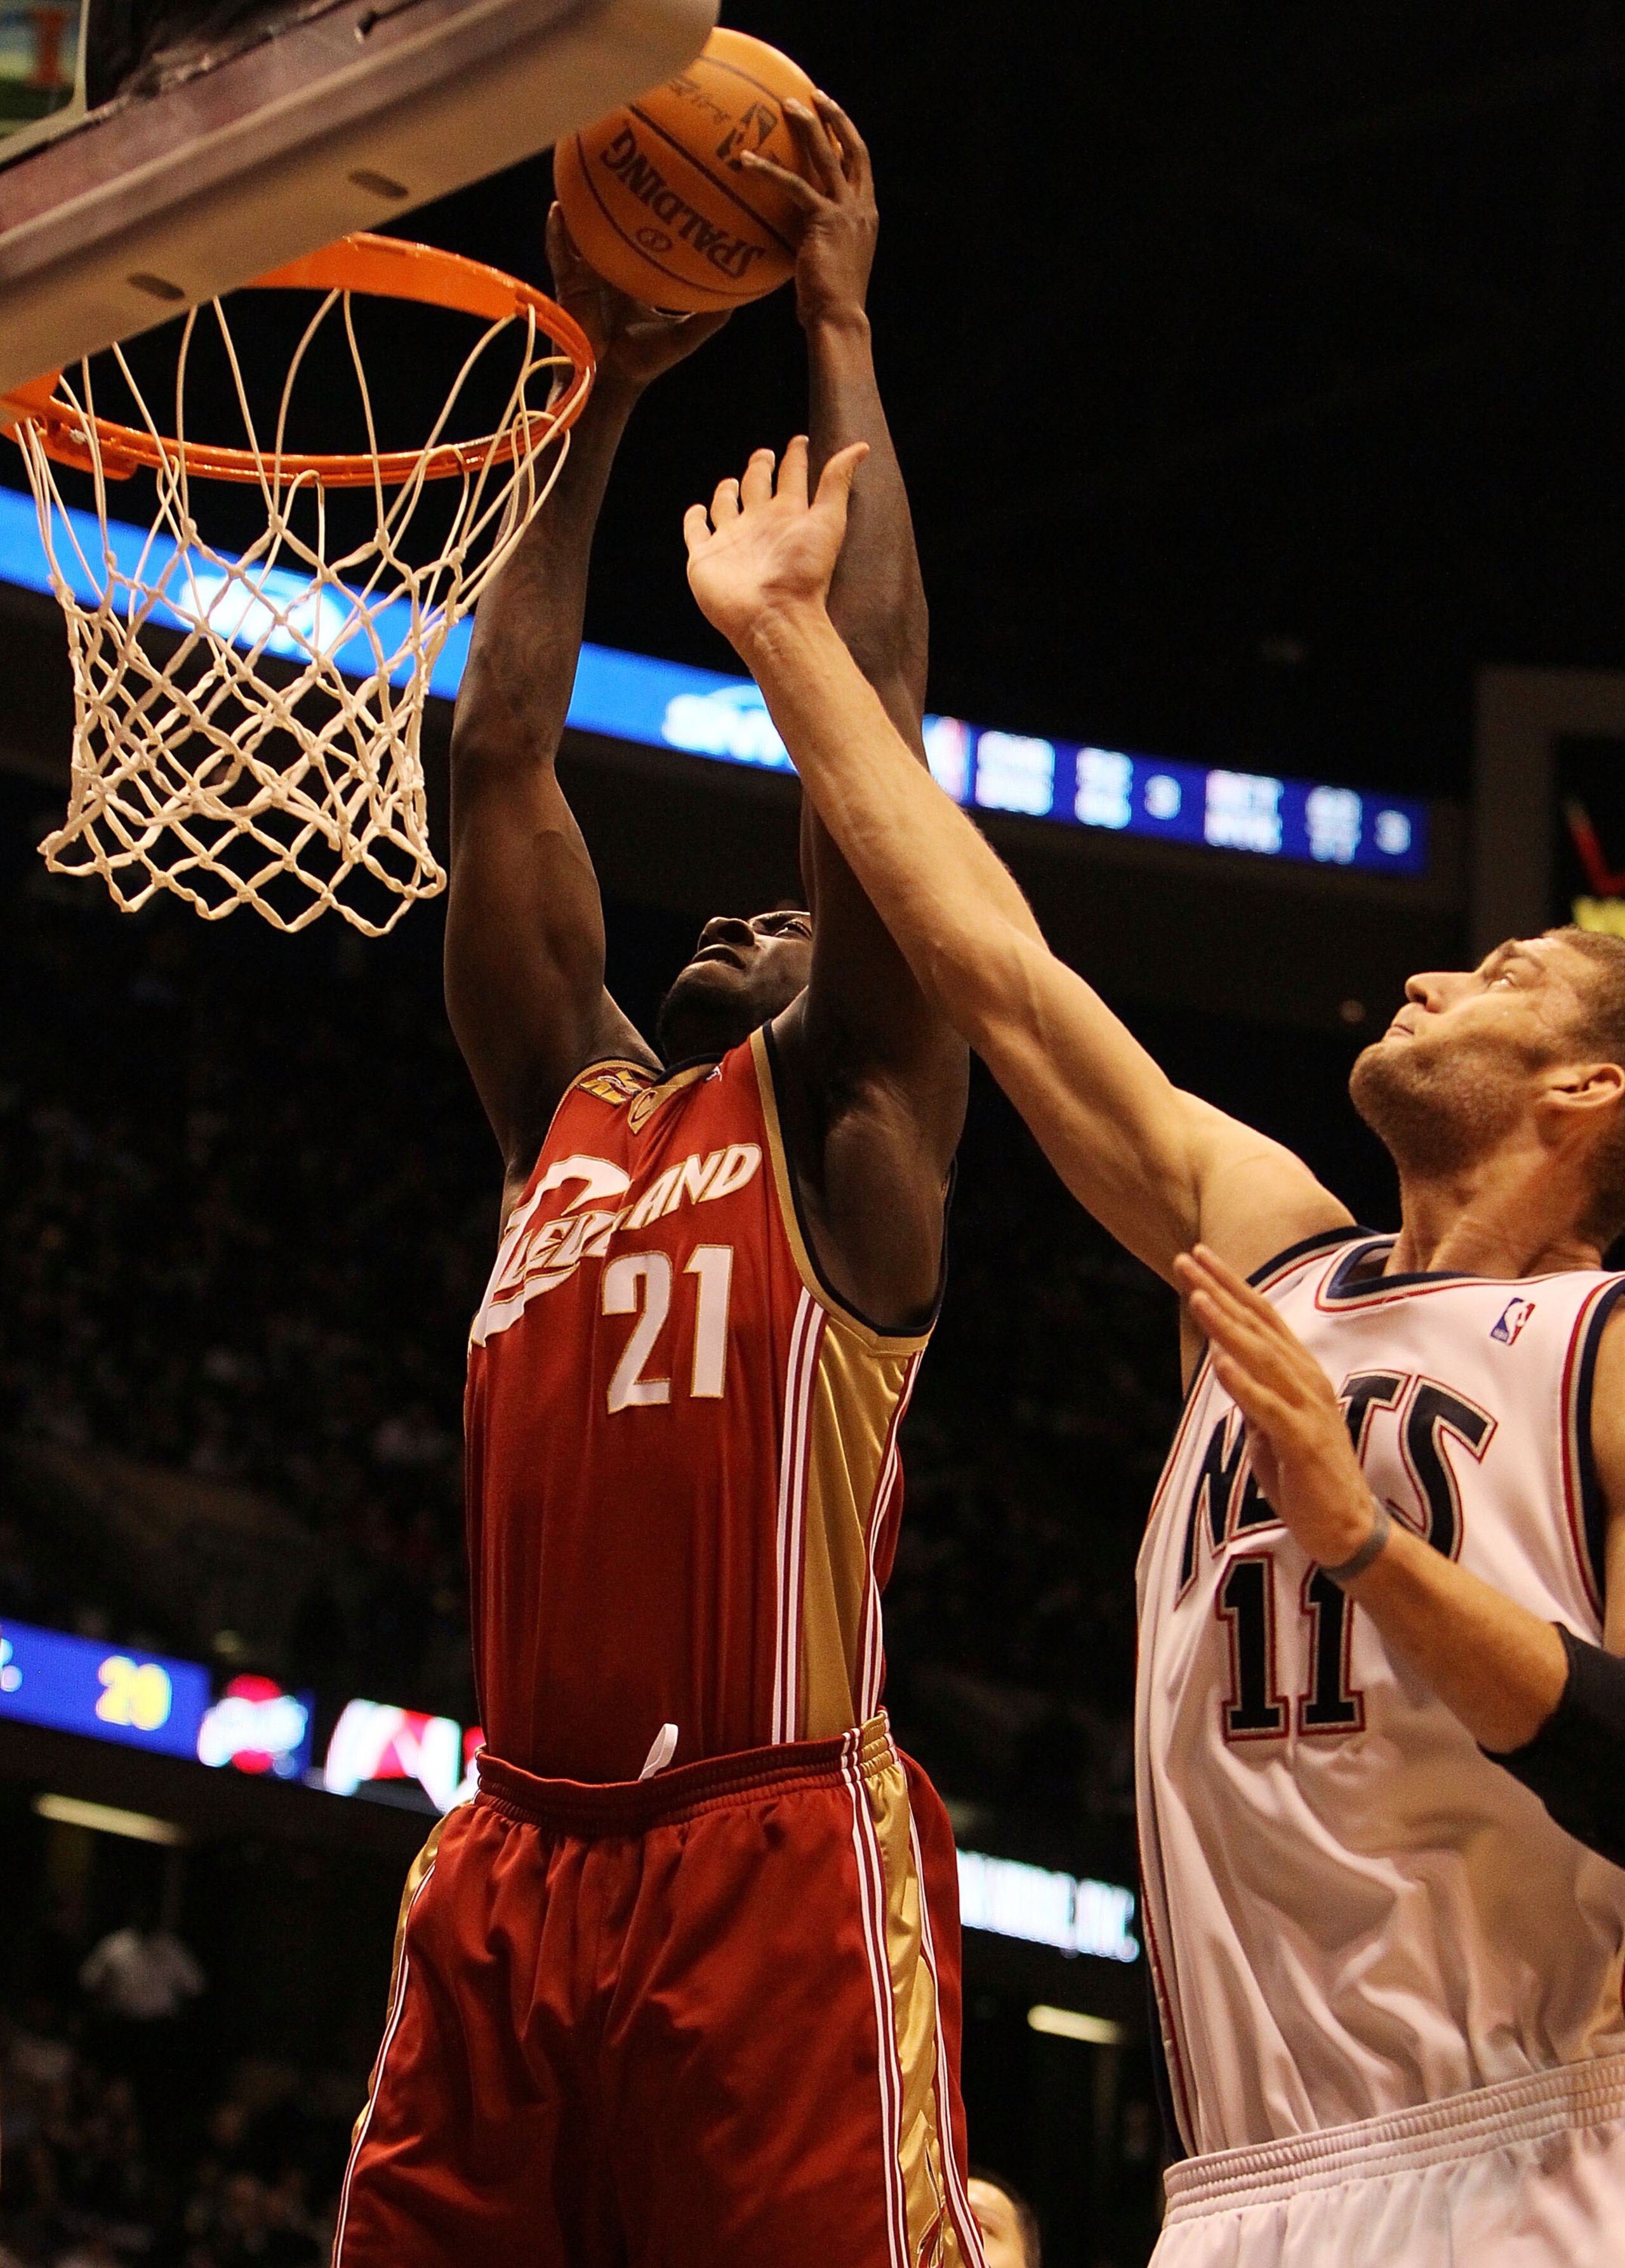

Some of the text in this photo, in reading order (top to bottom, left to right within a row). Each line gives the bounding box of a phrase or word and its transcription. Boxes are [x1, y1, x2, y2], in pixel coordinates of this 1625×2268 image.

[599, 123, 766, 278] SPALDING
[601, 1244, 734, 1415] 21
[1216, 1551, 1366, 1742] 11
